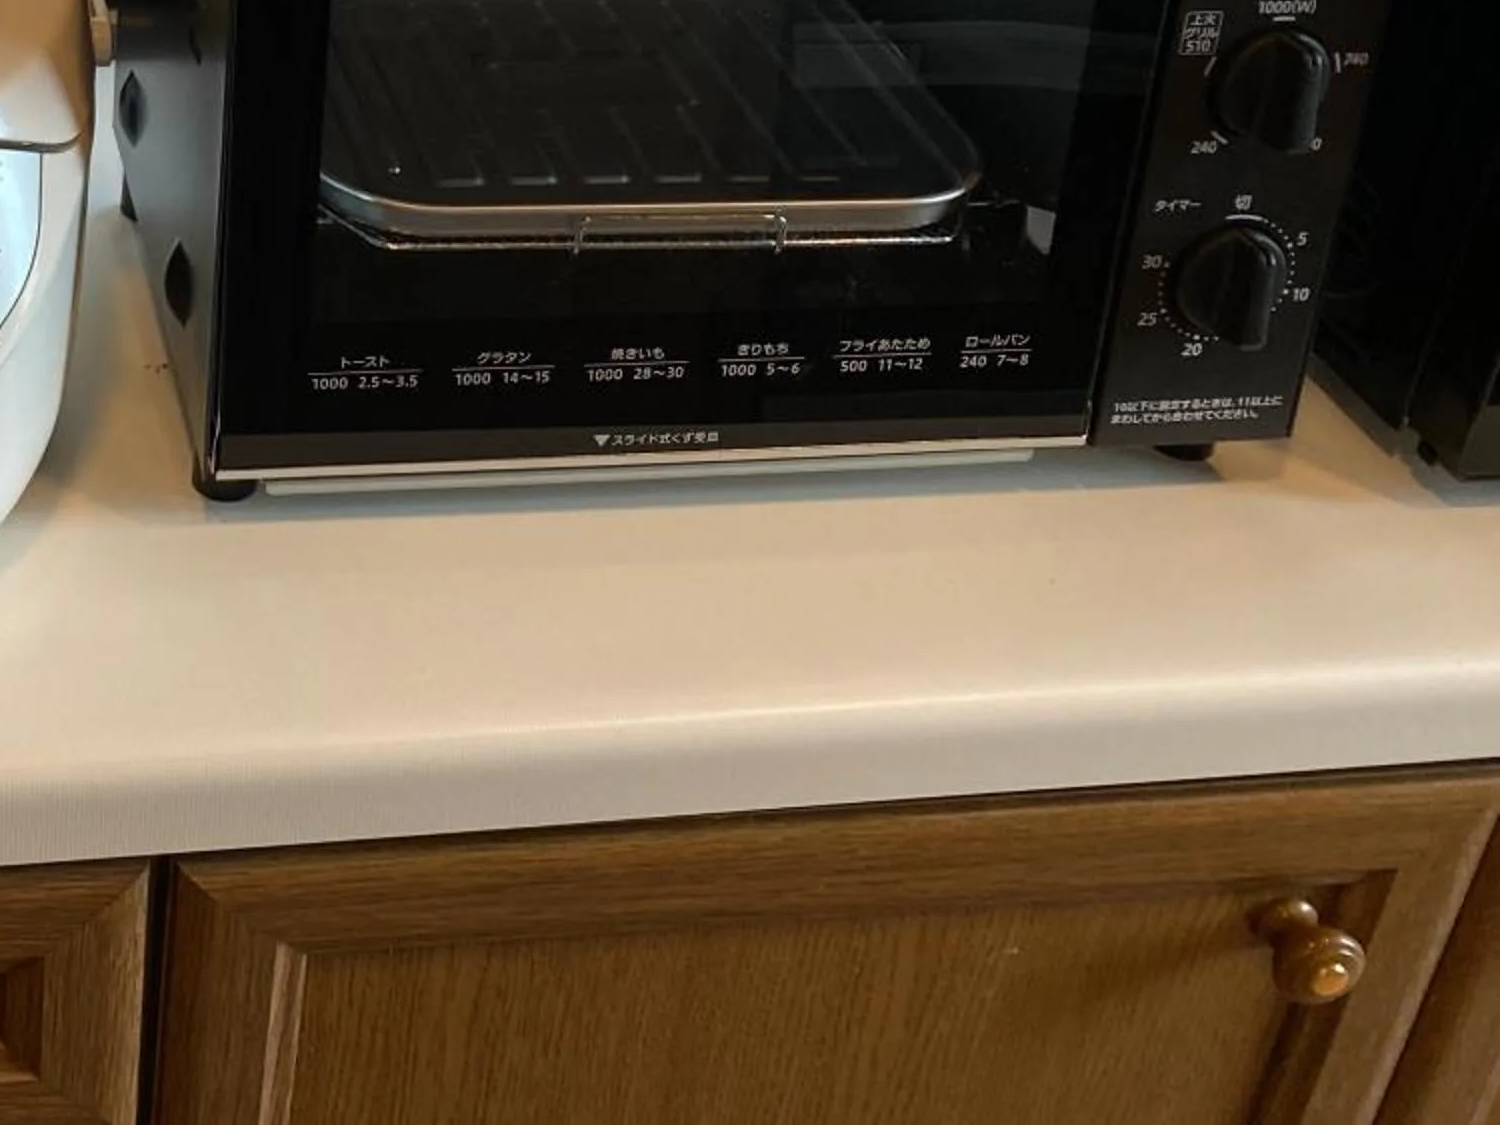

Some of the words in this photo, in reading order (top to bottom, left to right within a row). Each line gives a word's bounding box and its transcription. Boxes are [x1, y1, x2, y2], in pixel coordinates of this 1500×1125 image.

[1155, 199, 1202, 212] タイマー
[1297, 232, 1309, 246] 5
[1142, 254, 1163, 270] 30
[1292, 287, 1311, 302] 10
[1137, 312, 1158, 326] 25
[839, 337, 931, 353] フライあたため
[965, 334, 1032, 348] ロールパン
[1181, 342, 1203, 357] 20
[341, 355, 390, 369] トースト
[477, 351, 532, 365] グラタン
[960, 355, 987, 369] 240
[721, 363, 757, 377] 1000
[840, 359, 868, 373] 500
[455, 372, 492, 386] 1000
[587, 368, 624, 382] 1000
[312, 376, 349, 391] 1000
